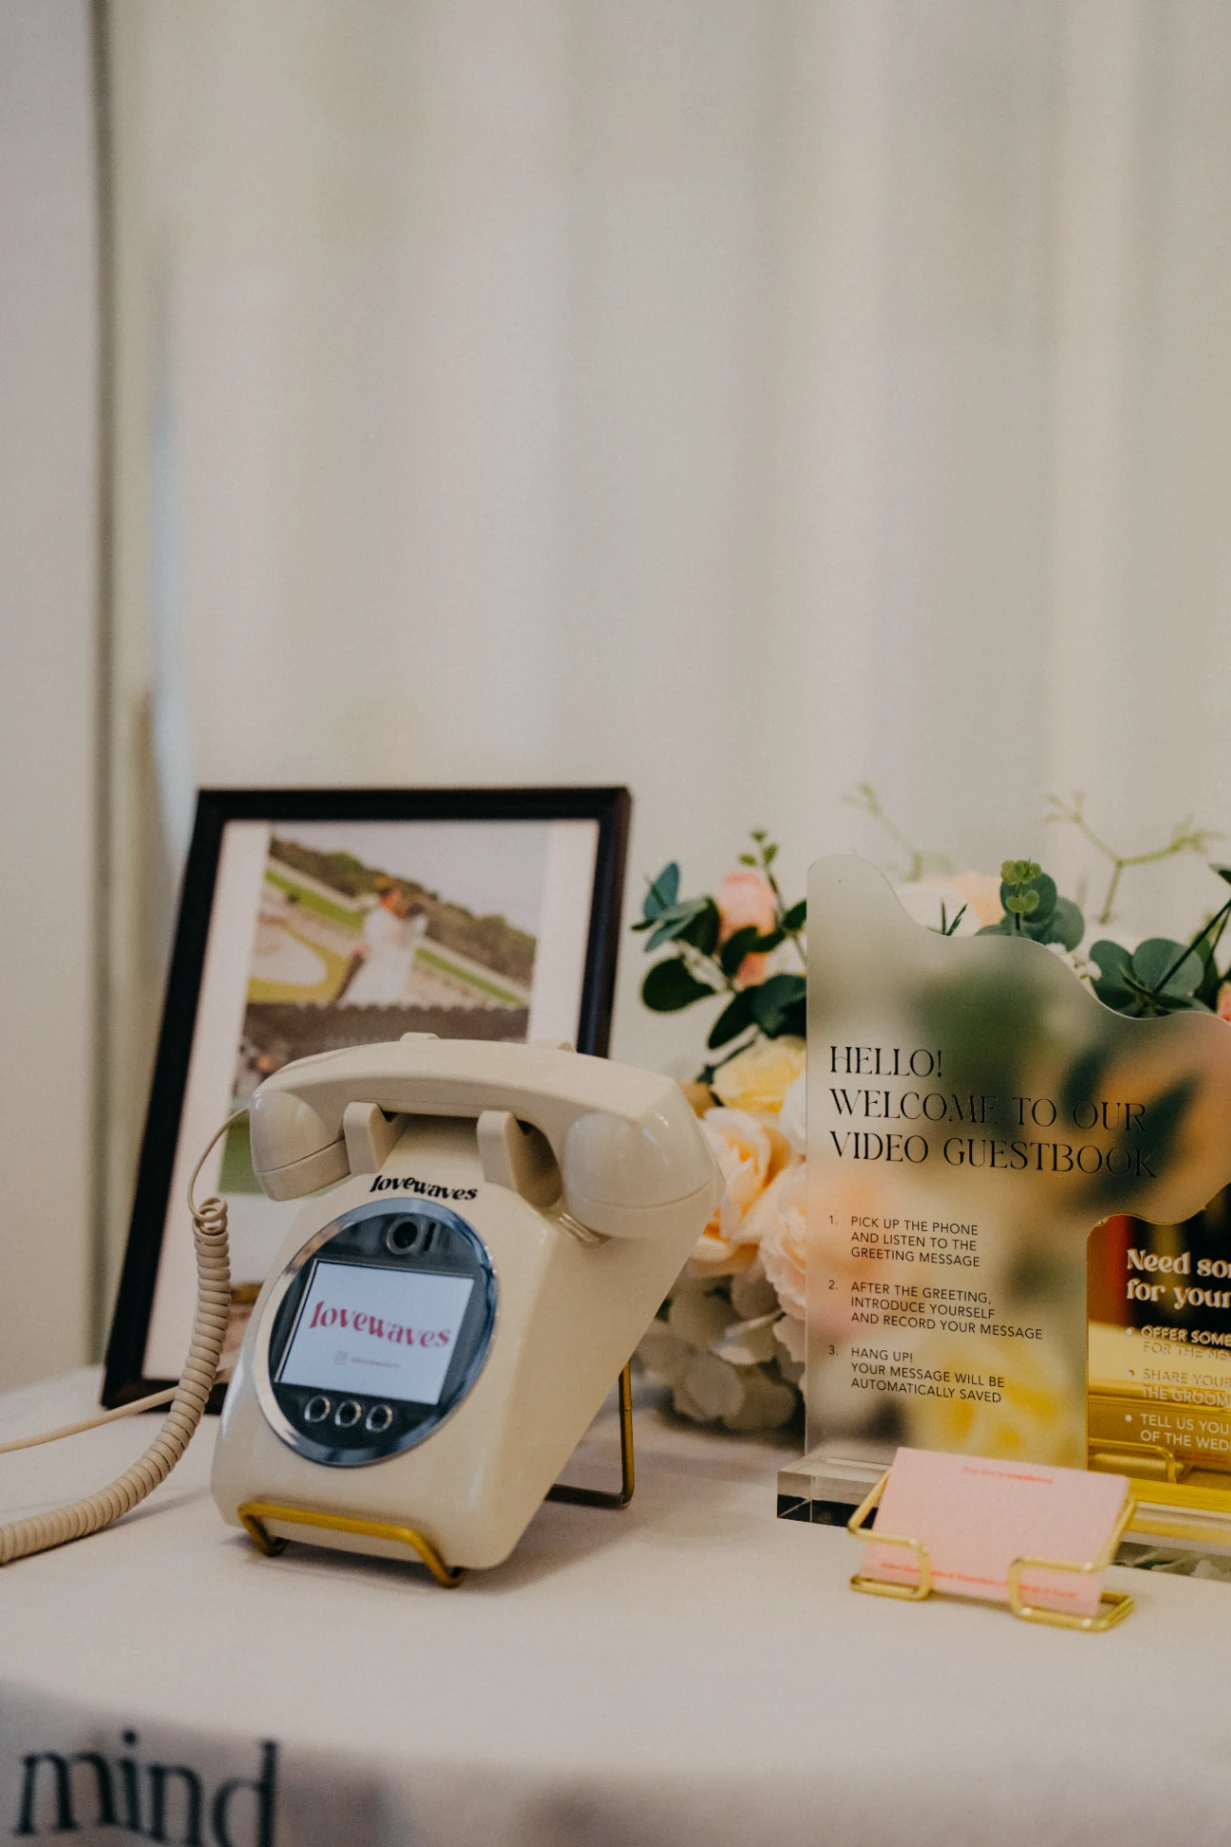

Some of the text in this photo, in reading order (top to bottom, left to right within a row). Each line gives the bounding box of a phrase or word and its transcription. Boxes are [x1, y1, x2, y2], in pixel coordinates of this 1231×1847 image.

[830, 1046, 943, 1078] HELLO!
[830, 1088, 1147, 1132] WELCOME TO OUR
[830, 1130, 1157, 1178] VIDEO GUESTBOOK
[369, 1174, 478, 1201] lovewaves
[829, 1215, 978, 1236] 1. PICK UP THE PHONE
[851, 1232, 977, 1251] AND LISTEN TO THE
[851, 1246, 980, 1267] GREETING MESSAGE
[1126, 1248, 1231, 1279] Need so
[828, 1280, 991, 1305] 2. AFTER THE GREETING,
[1126, 1277, 1166, 1302] for
[851, 1297, 995, 1320] INTRODUCE YOURSELF
[309, 1301, 452, 1348] lovewaves
[851, 1312, 1043, 1340] AND RECORD YOUR MESSAGE
[1141, 1325, 1188, 1342] OFFER
[828, 1345, 913, 1363] 3. HANG UP!
[1143, 1341, 1231, 1361] FOR THE NE
[851, 1362, 1005, 1388] YOUR MESSAGE WILL BE
[1143, 1368, 1189, 1384] SHARE
[851, 1377, 1001, 1403] AUTOMATICALLY SAVED
[1140, 1385, 1168, 1400] THE
[1140, 1413, 1231, 1435] TELL US YOU
[1140, 1430, 1231, 1452] OF THE WED
[14, 1729, 278, 1847] mind
